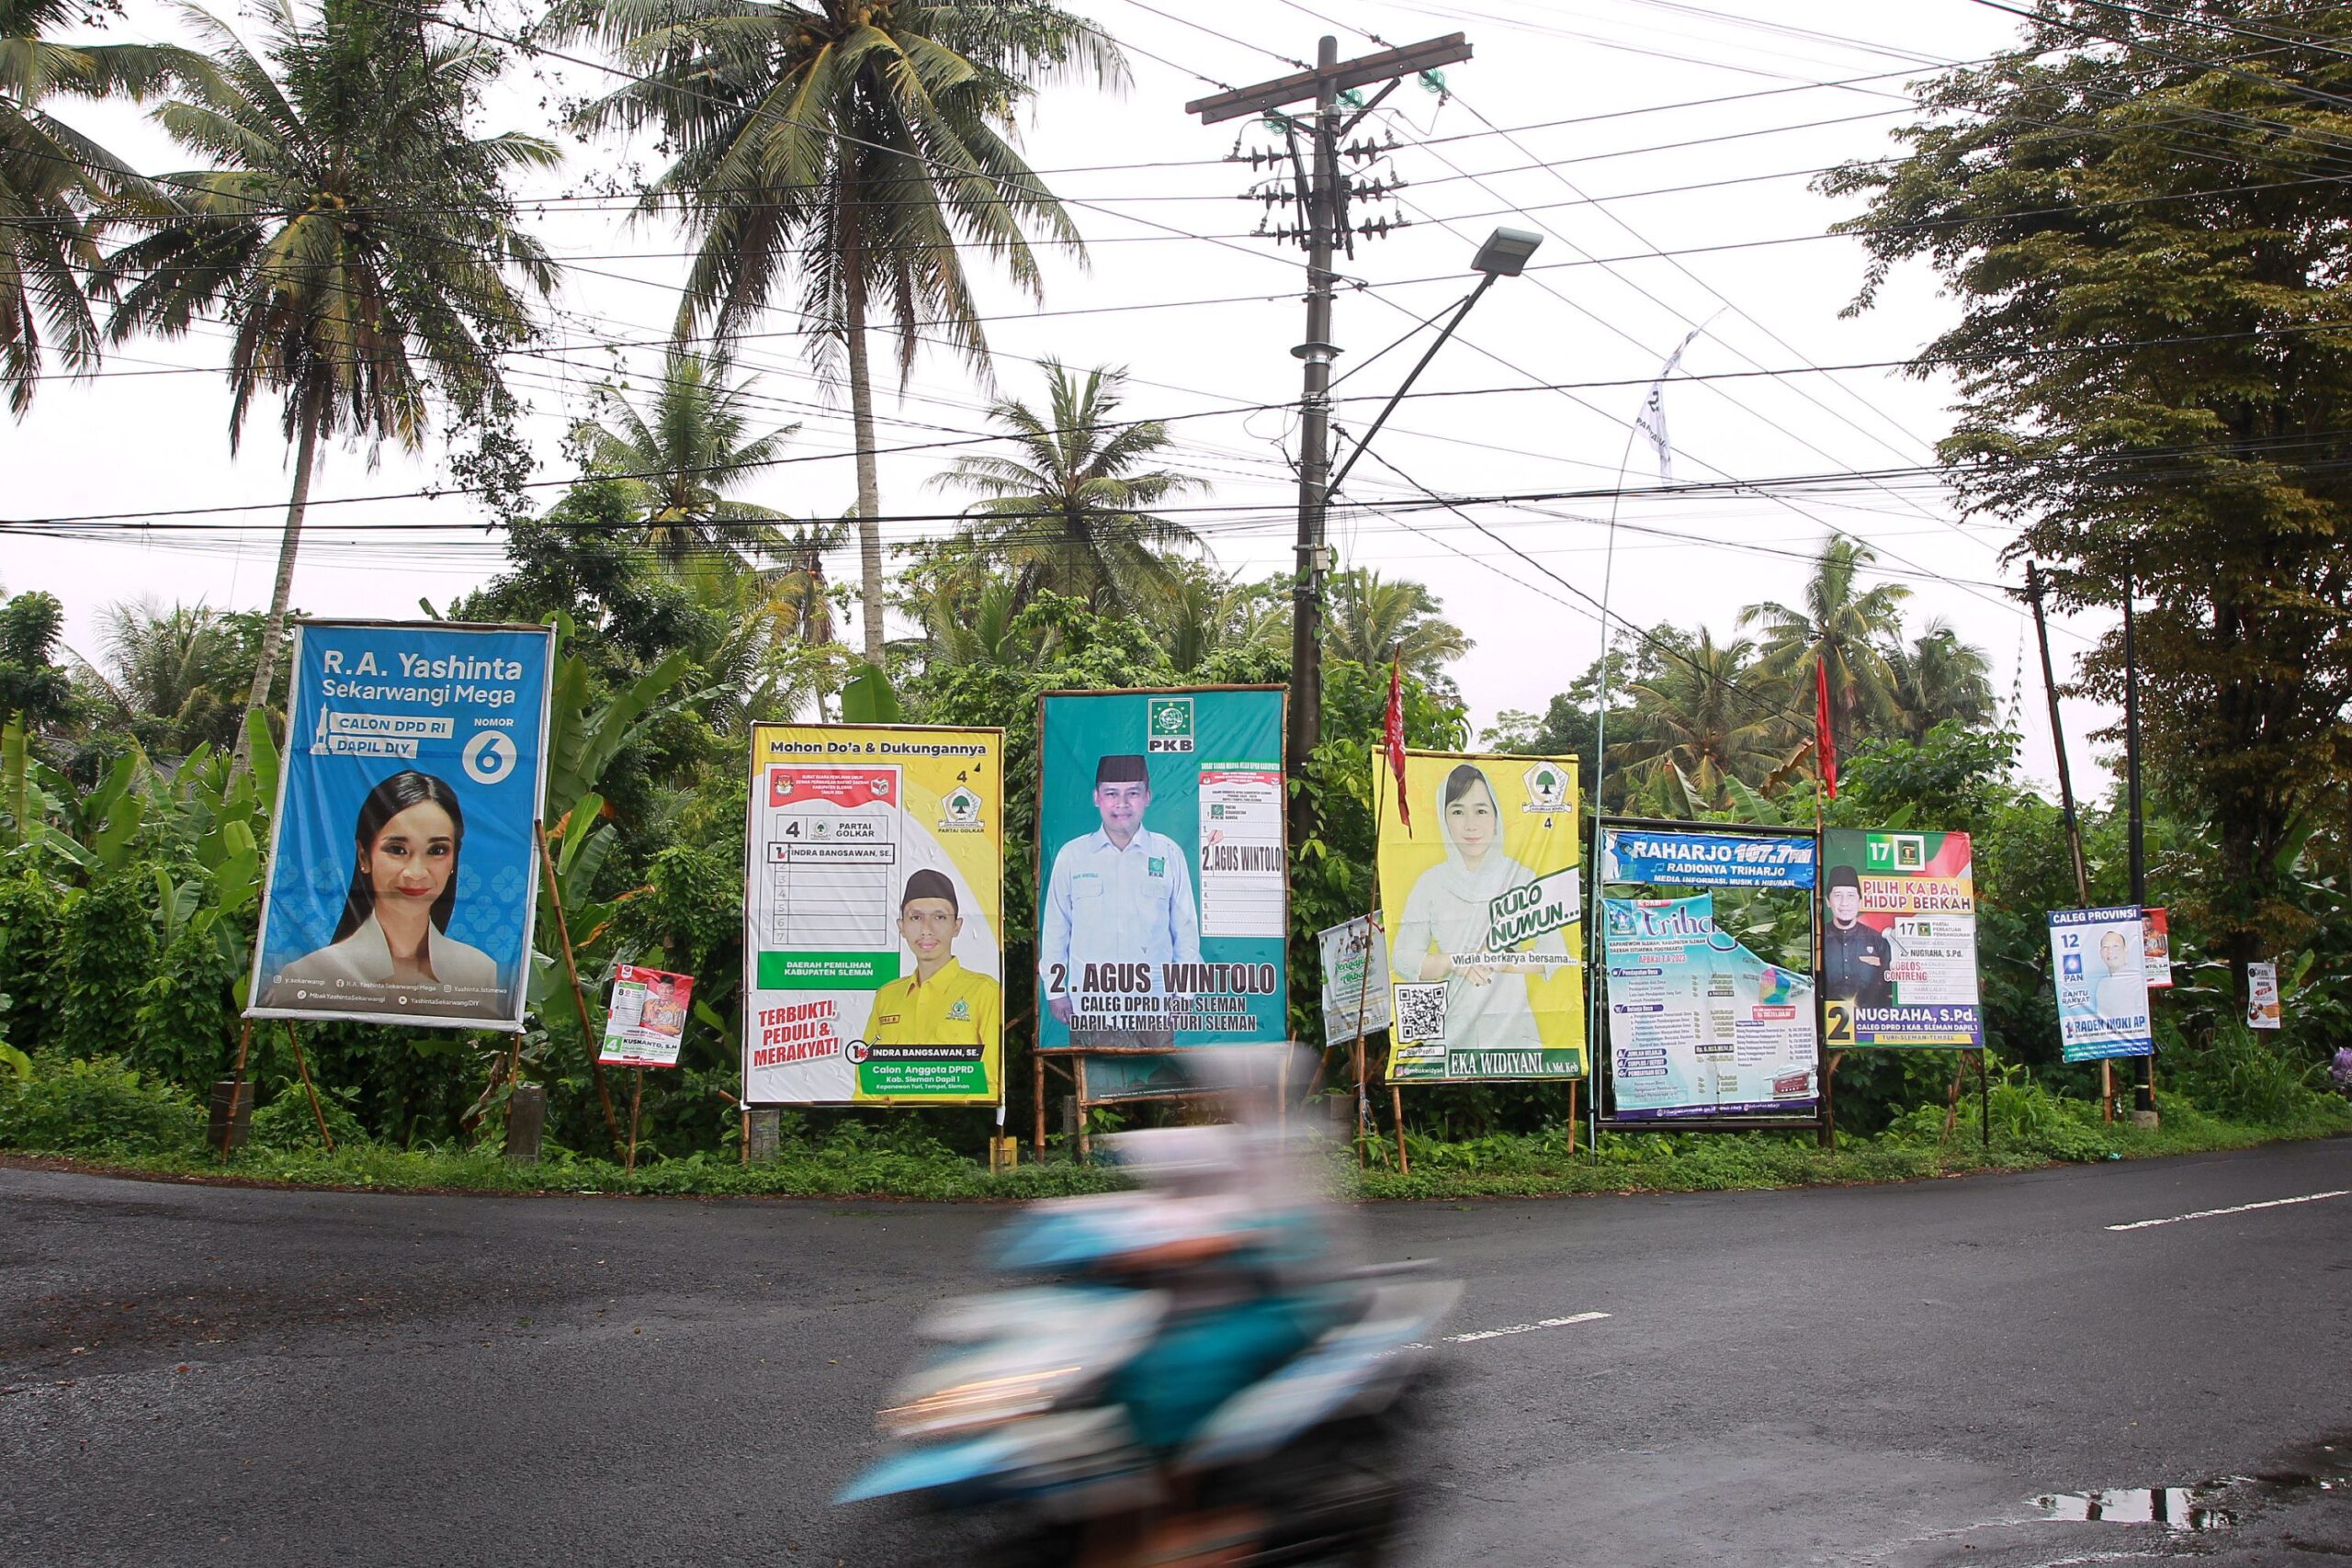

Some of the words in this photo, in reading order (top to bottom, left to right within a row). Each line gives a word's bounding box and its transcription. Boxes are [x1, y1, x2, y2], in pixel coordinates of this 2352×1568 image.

[323, 650, 388, 677] R.A.
[399, 652, 523, 681] Yashinta
[322, 679, 450, 706] Sekarwangi
[454, 685, 515, 708] Mega
[339, 718, 390, 731] CALON
[395, 721, 426, 733] DPD
[431, 722, 446, 733] RI
[474, 718, 514, 727] NOMOR
[337, 740, 380, 752] DAPIL
[385, 741, 411, 753] DIY
[771, 741, 822, 753] Mohon
[827, 741, 861, 754] Do'a
[865, 742, 876, 753] &
[880, 742, 987, 757] Dukungannya
[1149, 739, 1193, 750] PKB
[475, 738, 503, 774] 6
[956, 770, 967, 783] 4
[786, 821, 800, 838] 4
[1544, 817, 1552, 829] 4
[819, 850, 878, 858] BANGSAWAN,
[1633, 841, 1732, 862] RAHARJO
[1870, 842, 1891, 861] 17
[1203, 846, 1213, 871] 2.
[1215, 846, 1238, 871] AGUS
[1241, 846, 1281, 872] WINTOLO
[1667, 863, 1727, 874] RADIONYA
[1731, 865, 1785, 876] TRIHARJO
[778, 875, 786, 884] 3
[1682, 876, 1727, 886] INFORMASI,
[778, 889, 786, 898] 4
[1863, 881, 1898, 894] PILIH
[778, 904, 785, 912] 5
[1496, 885, 1542, 918] KULO
[1864, 896, 1906, 908] HIDUP
[1913, 897, 1970, 909] BERKAH
[778, 919, 785, 927] 6
[2053, 912, 2086, 923] CALEG
[2087, 909, 2137, 920] PROVINSI
[1492, 902, 1579, 946] NUWUN...
[1899, 922, 1915, 935] 17
[2061, 933, 2079, 948] 12
[1453, 953, 1480, 964] Widia
[1484, 953, 1525, 964] berkarya
[1529, 953, 1577, 964] bersama...
[1083, 963, 1151, 993] AGUS
[1162, 963, 1275, 994] WINTOLO
[1884, 972, 1927, 981] CONTRENG
[1080, 997, 1121, 1012] CALEG
[1125, 997, 1159, 1012] DPRD
[1163, 997, 1193, 1012] Kab.
[1196, 997, 1246, 1012] SLEMAN
[2062, 997, 2090, 1005] RAKYAT
[758, 1000, 836, 1027] TERBUKTI,
[1856, 1009, 1938, 1024] NUGRAHA,
[1940, 1009, 1977, 1021] S.Pd.
[1070, 1015, 1108, 1031] DAPIL
[1111, 1015, 1118, 1031] 1
[1121, 1015, 1169, 1031] TEMPEL
[1172, 1015, 1202, 1031] TURI
[1205, 1015, 1256, 1031] SLEMAN
[1828, 1007, 1849, 1040] 2
[2075, 1020, 2104, 1032] RADEN
[2134, 1016, 2145, 1028] AP
[763, 1025, 815, 1045] PEDULI
[819, 1022, 831, 1037] &
[607, 1038, 617, 1051] 4
[753, 1042, 839, 1066] MERAKYAT!
[902, 1049, 965, 1057] BANGSAWAN,
[1451, 1053, 1476, 1074] EKA
[1480, 1053, 1544, 1074] WIDIYANI
[1566, 1063, 1578, 1073] Keb
[873, 1066, 900, 1074] Calon
[905, 1066, 947, 1076] Anggota
